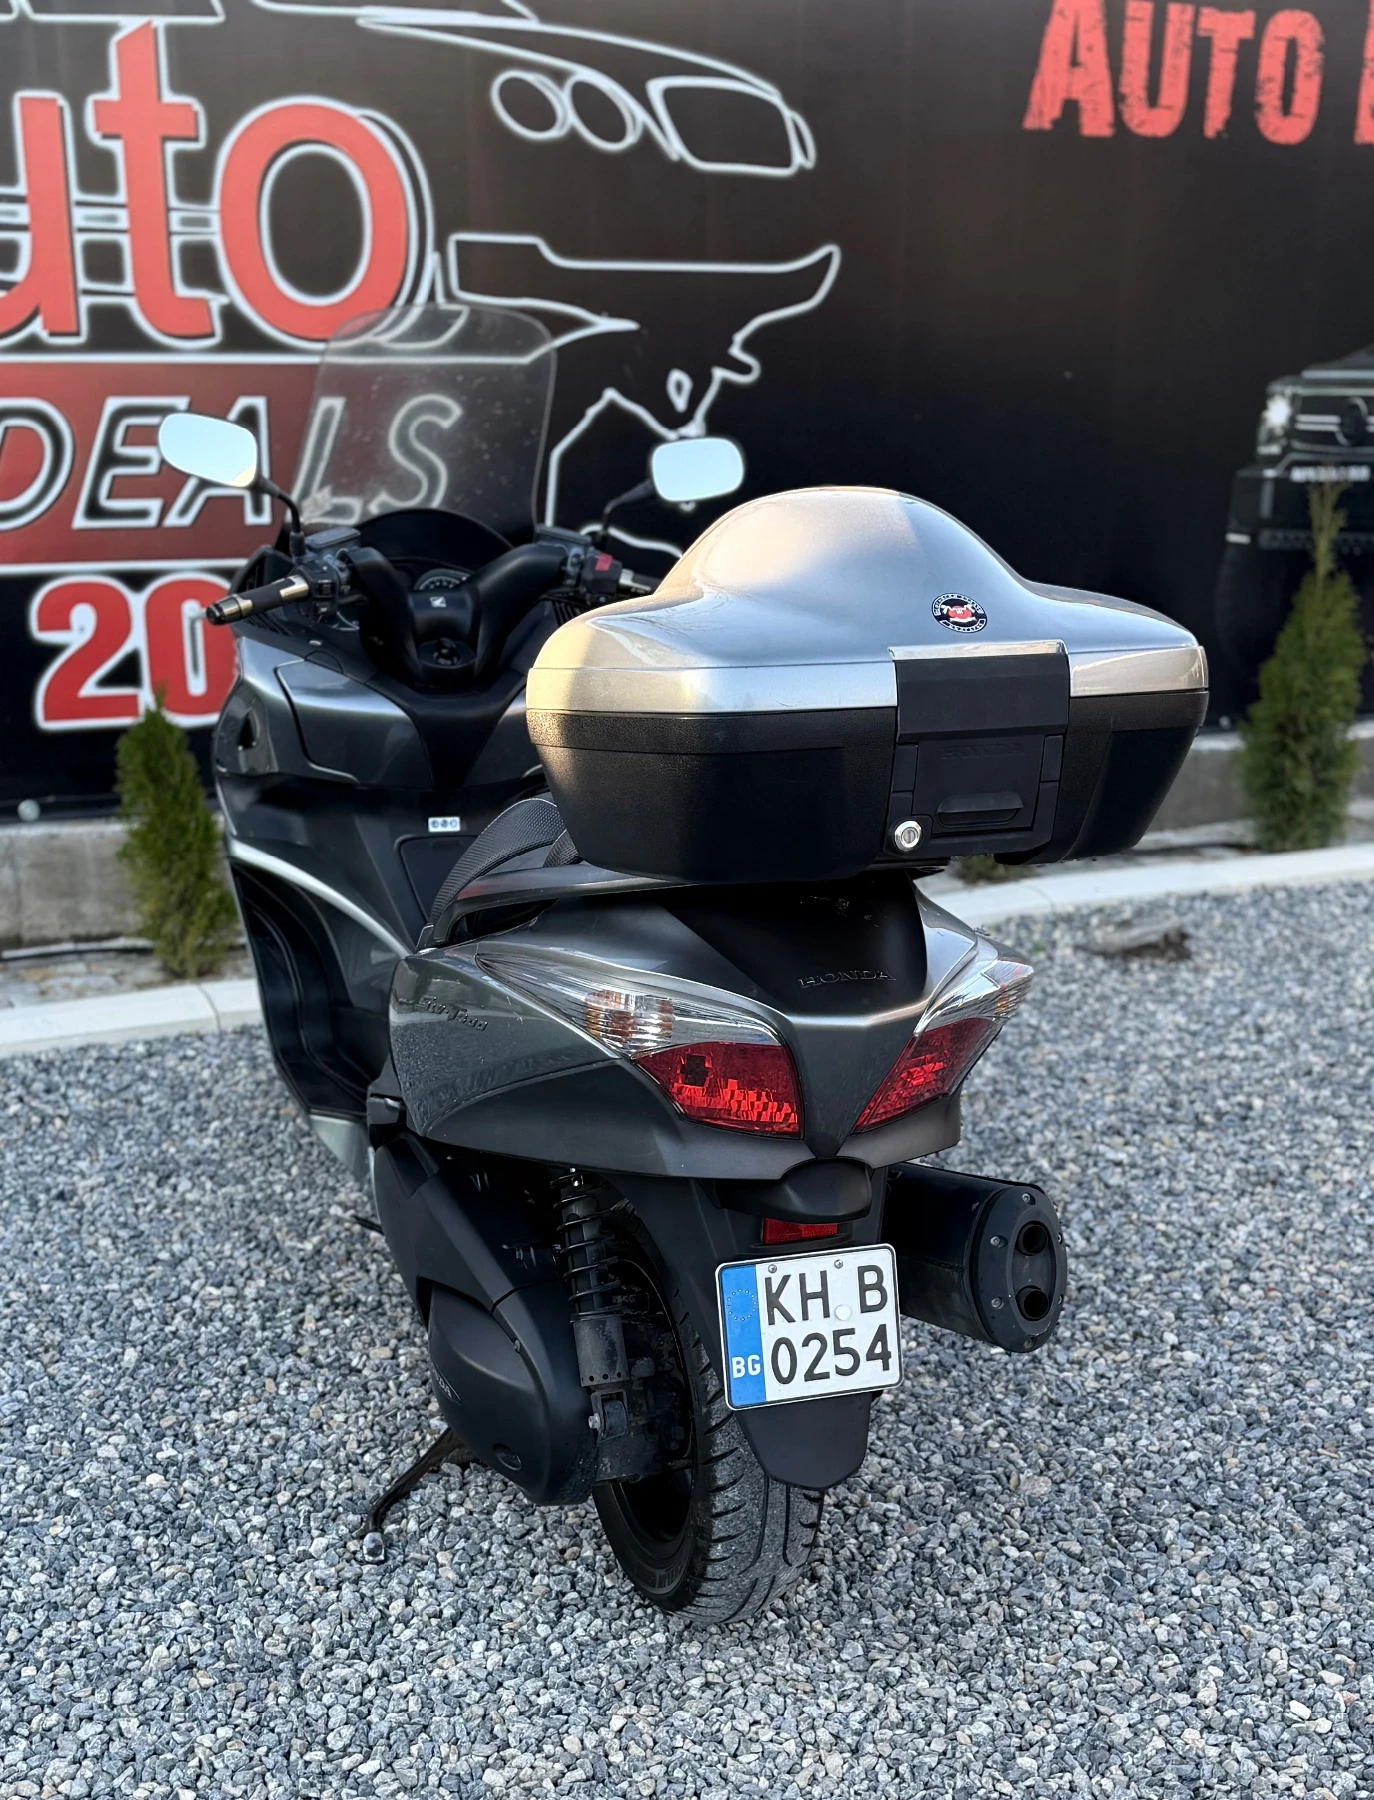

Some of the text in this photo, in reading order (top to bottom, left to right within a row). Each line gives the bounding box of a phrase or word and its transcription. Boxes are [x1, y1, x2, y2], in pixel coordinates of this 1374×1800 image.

[1022, 0, 1325, 145] AUTO
[797, 970, 897, 989] HONDA
[764, 1264, 888, 1326] KH B
[731, 1354, 761, 1379] BG
[771, 1323, 892, 1385] 0254
